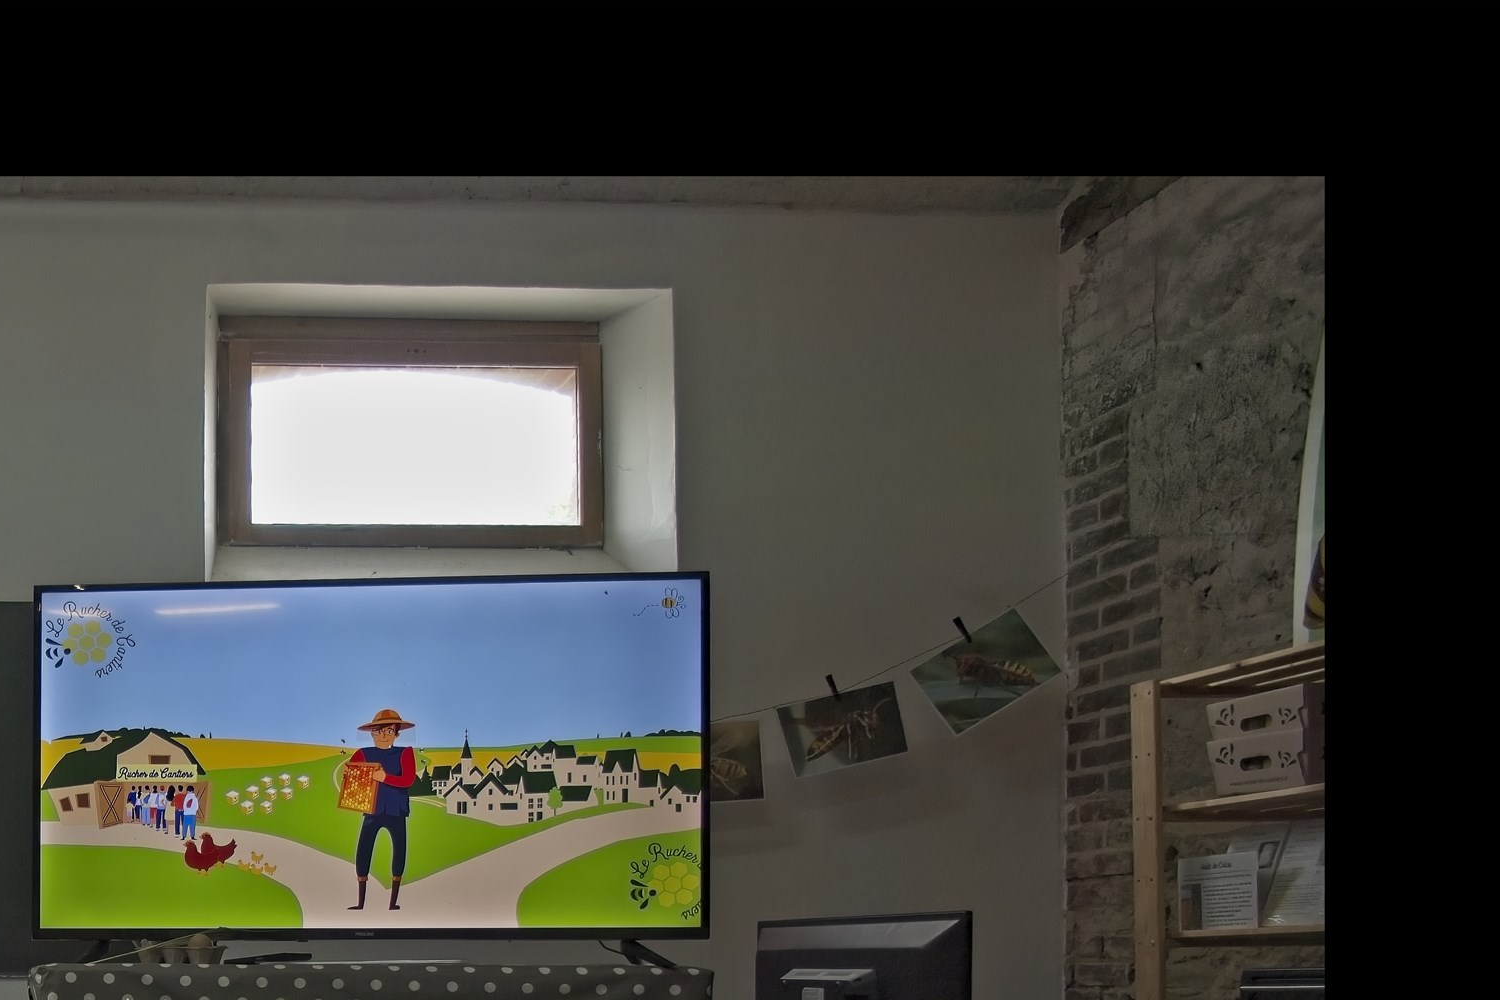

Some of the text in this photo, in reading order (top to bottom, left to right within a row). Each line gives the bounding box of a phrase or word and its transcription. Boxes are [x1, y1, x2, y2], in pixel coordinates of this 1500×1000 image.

[45, 601, 136, 678] Le Rucher de Cantiers
[117, 766, 194, 779] Rucher de Cantiers
[630, 843, 698, 879] Le Rucher
